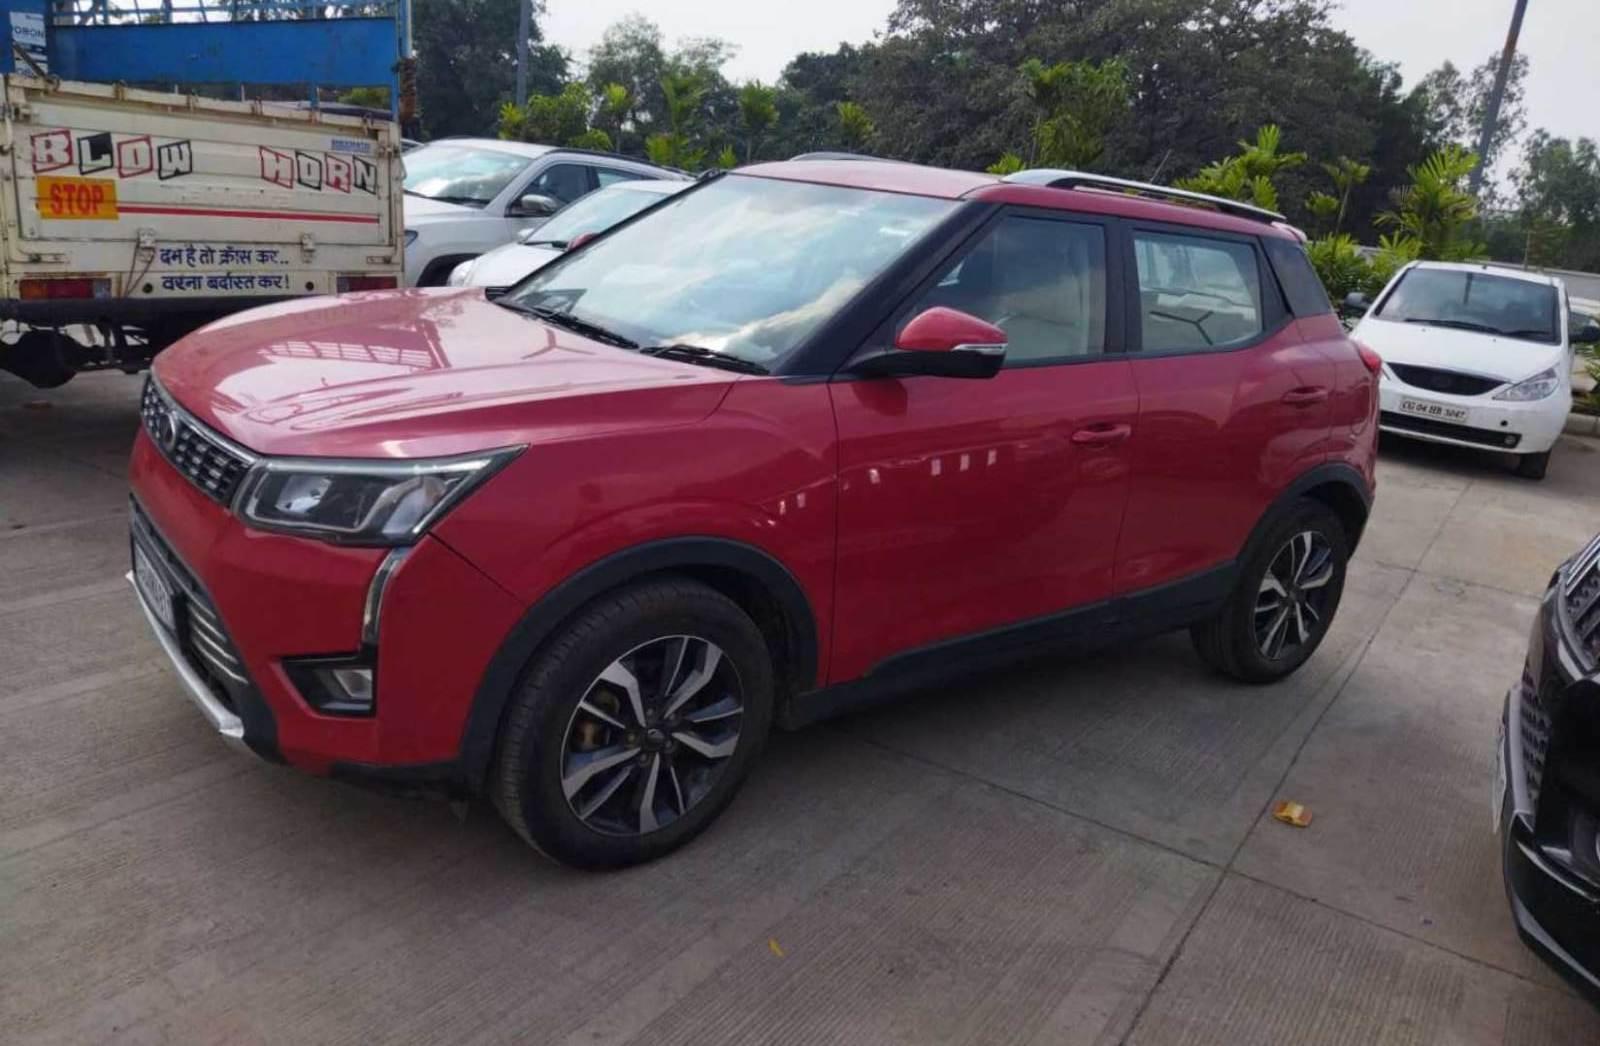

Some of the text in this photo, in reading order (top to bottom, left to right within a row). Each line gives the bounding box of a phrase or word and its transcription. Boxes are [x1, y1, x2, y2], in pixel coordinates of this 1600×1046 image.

[259, 145, 377, 194] HORN
[50, 183, 104, 215] STOP
[160, 248, 182, 265] दम
[184, 243, 197, 268] है
[200, 246, 216, 264] तो
[161, 275, 203, 290] वरना
